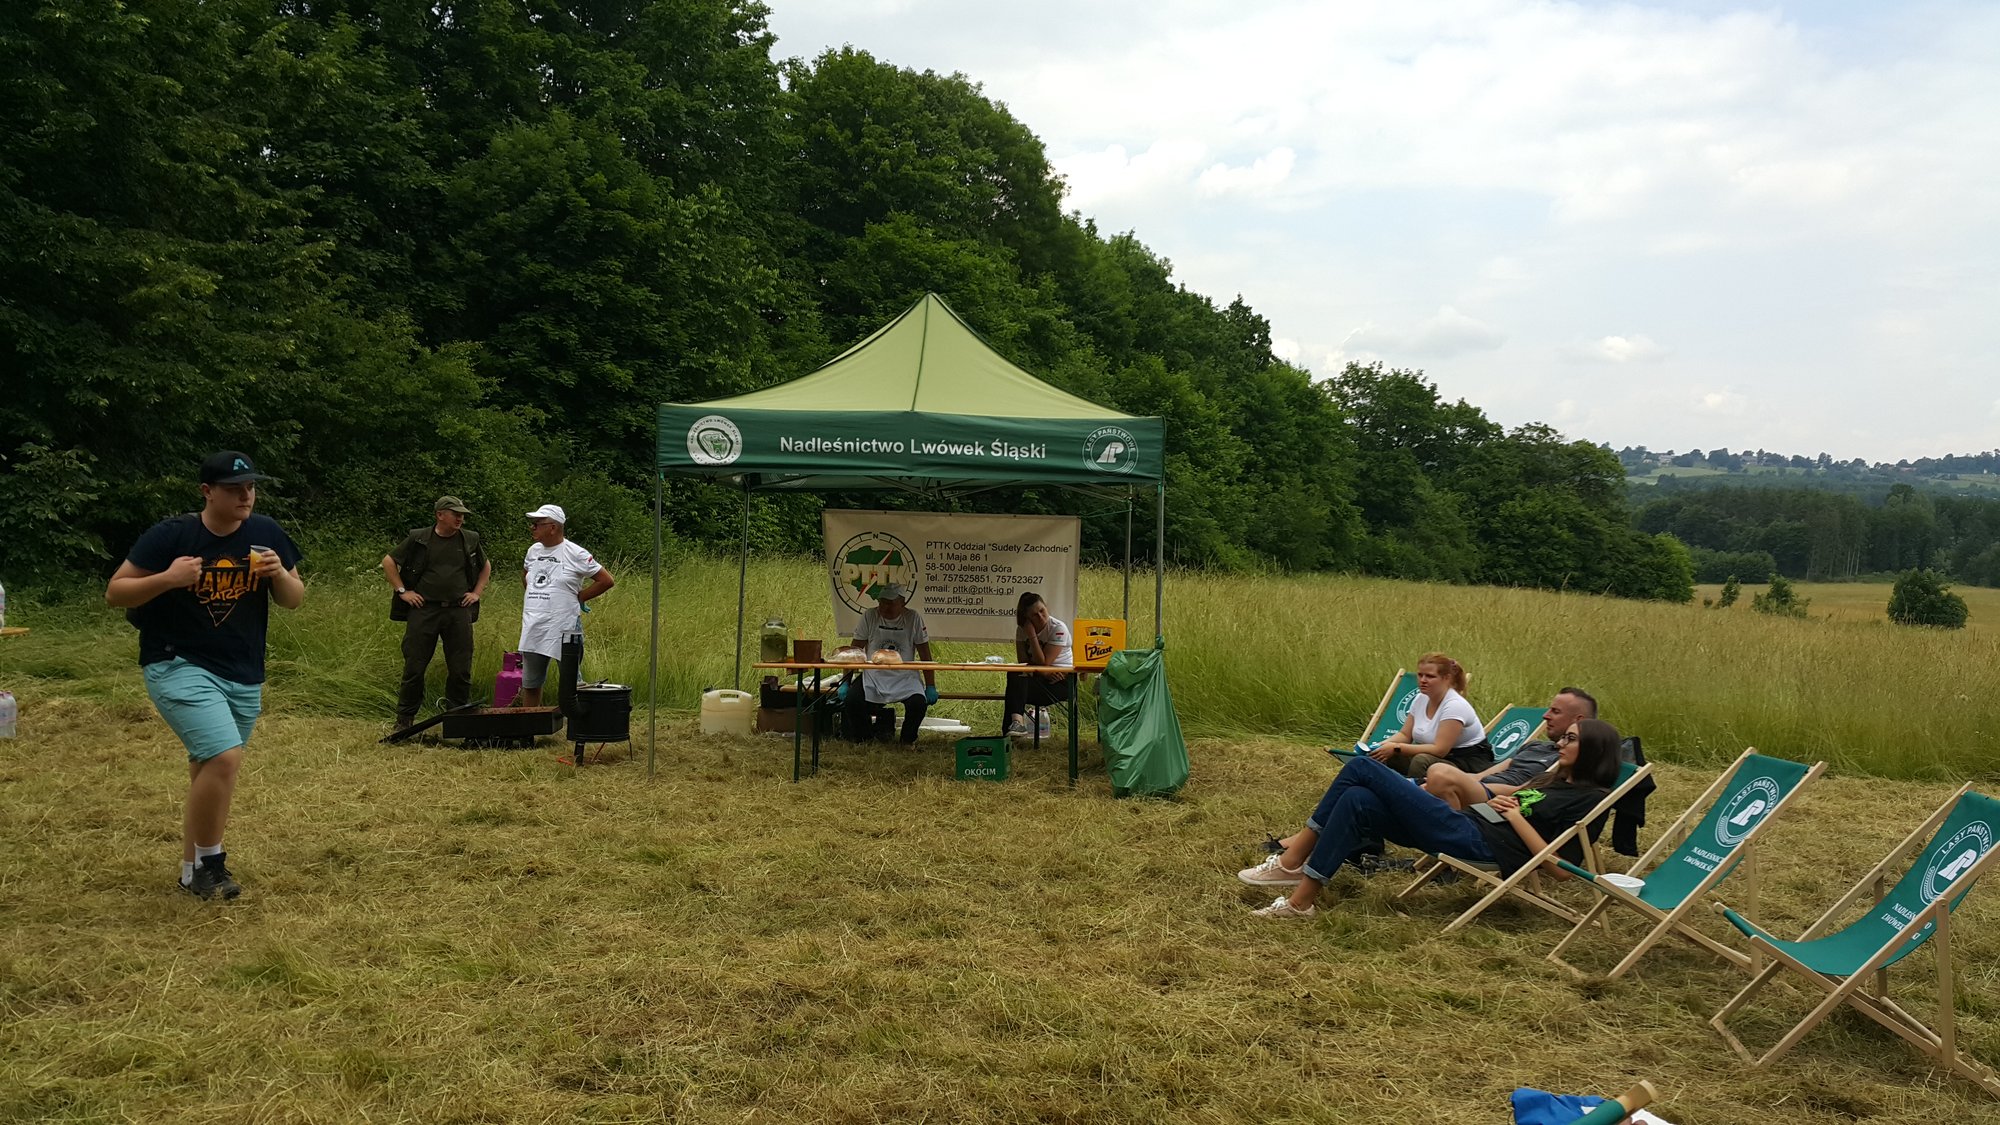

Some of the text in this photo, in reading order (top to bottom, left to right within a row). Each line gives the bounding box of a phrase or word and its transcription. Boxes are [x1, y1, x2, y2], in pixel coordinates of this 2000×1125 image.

[780, 436, 1046, 460] Nadleśnictwo Lwówek Śląski
[1085, 434, 1097, 451] LASY
[926, 541, 951, 550] PTTK
[925, 552, 936, 560] ul.
[946, 552, 968, 563] Maja
[969, 553, 981, 561] 86
[925, 562, 1013, 573] 58-500 Jelenia Góra
[842, 564, 909, 586] PTTK
[924, 573, 940, 582] Tel.
[996, 575, 1044, 584] 757523627
[188, 571, 260, 592] AWAII
[924, 584, 1015, 596] email: pttk@pttk-jg.pl
[923, 596, 984, 606] www.pttk-jg.pl
[923, 607, 1018, 617] www.przewodnik-sude
[1088, 645, 1113, 658] Piast
[964, 768, 996, 776] OKOCIM
[1731, 784, 1752, 806] LASY
[1941, 824, 1989, 856] LASY PAŃSTWO
